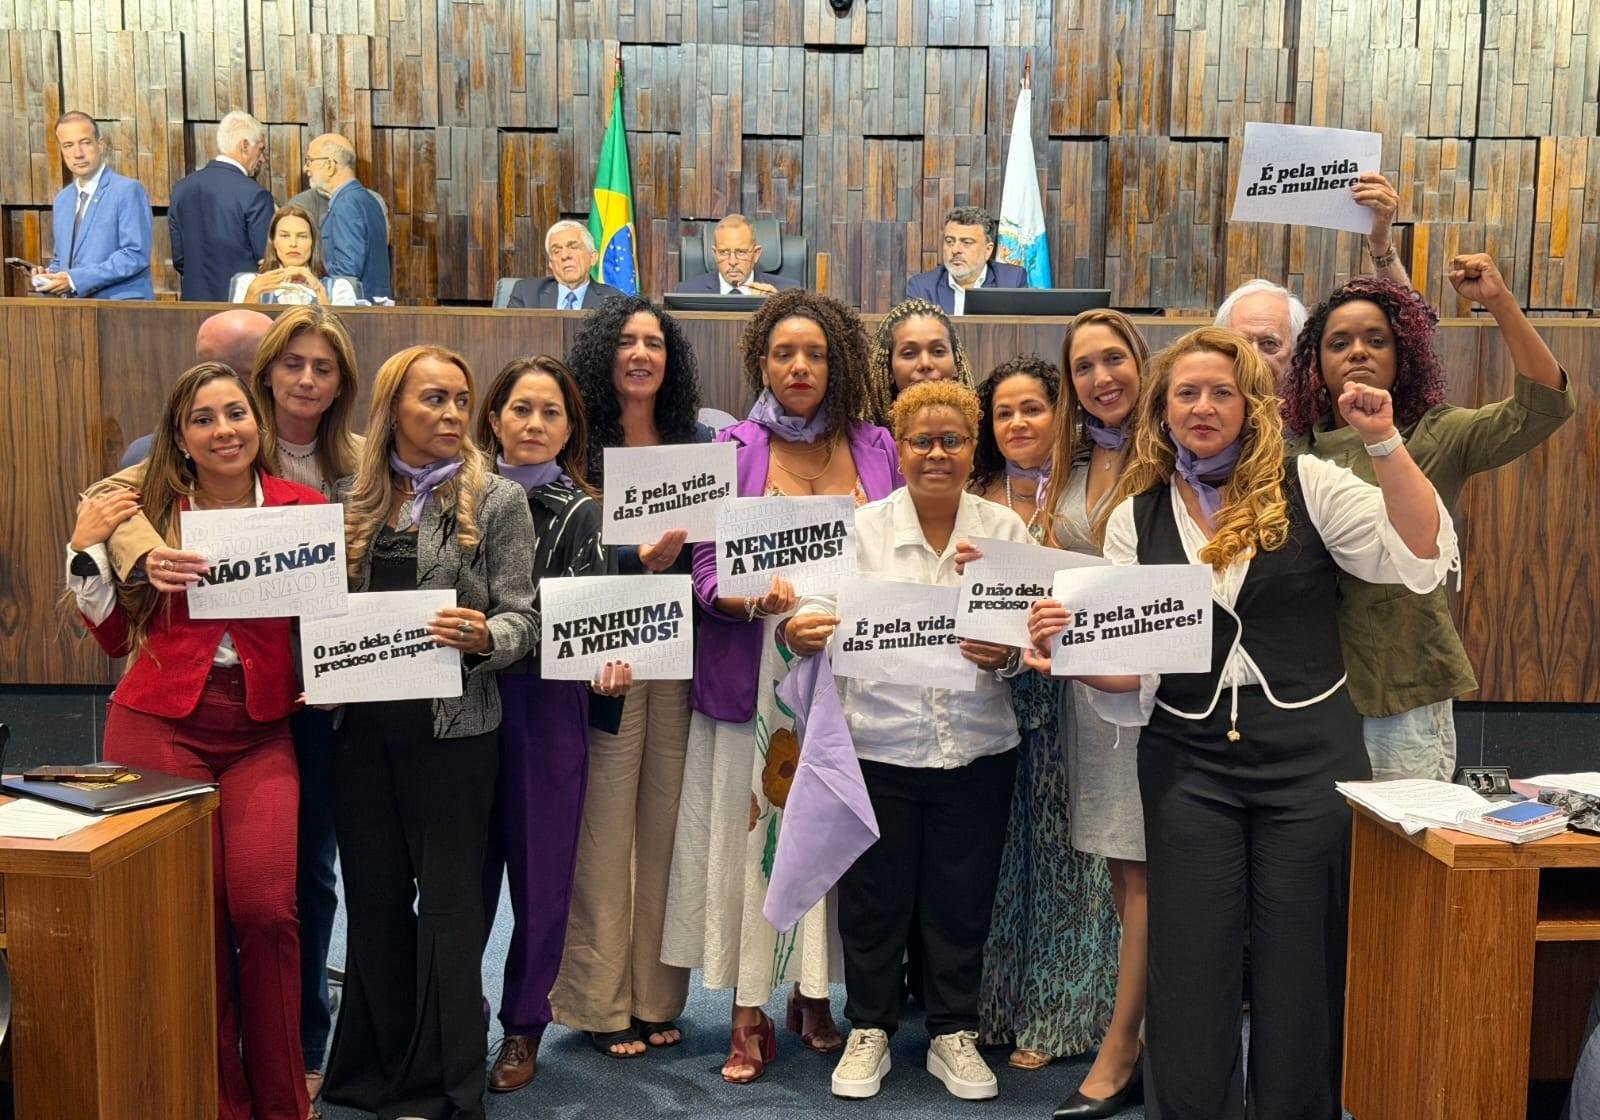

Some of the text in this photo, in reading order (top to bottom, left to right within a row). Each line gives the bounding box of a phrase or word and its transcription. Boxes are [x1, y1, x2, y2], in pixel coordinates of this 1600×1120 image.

[1246, 177, 1359, 196] das mulhere
[1260, 159, 1358, 183] É pela vida
[613, 506, 643, 521] das
[648, 482, 730, 514] mulheres!
[625, 473, 716, 504] É pela vida
[726, 520, 847, 558] NENHUMA
[197, 542, 336, 587] NÃO É NÃO!
[731, 539, 843, 575] A MENOS!
[968, 597, 1029, 613] precioso
[972, 583, 984, 596] O
[985, 583, 1013, 596] não
[1015, 584, 1045, 597] dela
[552, 601, 684, 641] NENHUMA
[856, 615, 955, 638] É pela vida
[1061, 608, 1203, 646] das mulheres!
[1074, 597, 1185, 629] É pela vida
[313, 645, 326, 659] O
[328, 641, 357, 657] não
[359, 633, 390, 651] dela
[393, 628, 402, 643] é
[557, 641, 575, 659] A
[581, 620, 679, 655] MENOS!
[843, 633, 960, 651] das mulhere
[314, 652, 376, 678] precioso
[379, 649, 388, 660] e
